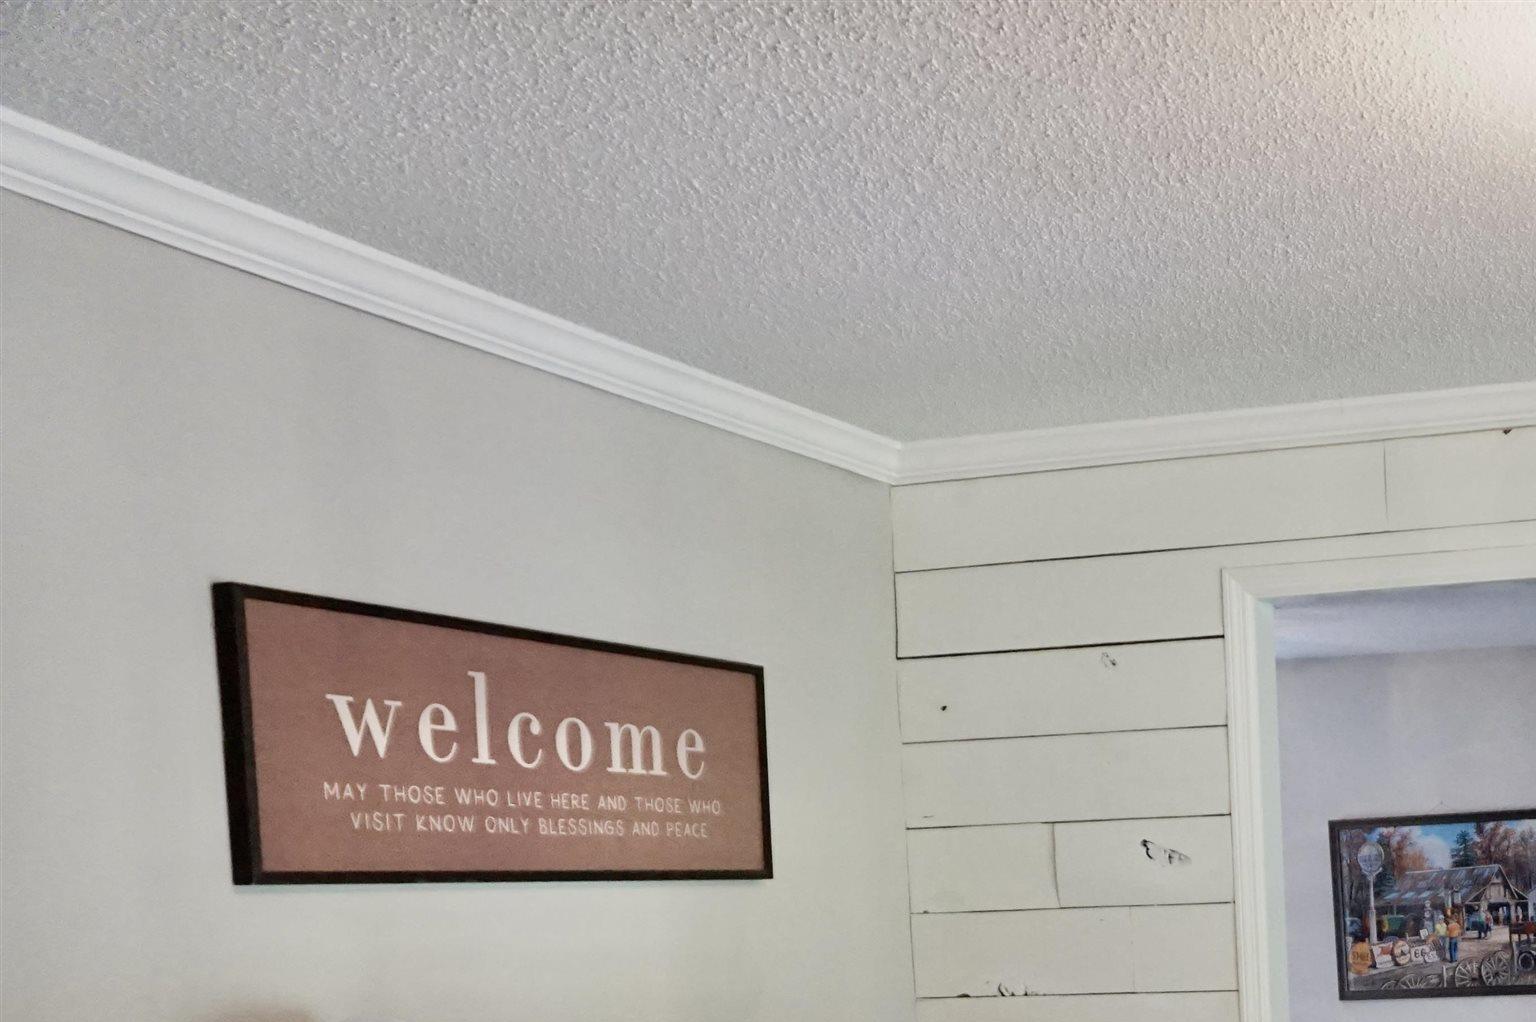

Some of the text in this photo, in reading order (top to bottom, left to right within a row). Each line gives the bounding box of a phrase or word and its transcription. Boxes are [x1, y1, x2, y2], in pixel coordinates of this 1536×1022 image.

[325, 671, 707, 780] welcome
[323, 781, 721, 815] MAY THOSE WHO LIVE HERE AND THOSE WHO
[350, 811, 708, 838] VISIT KNOW ONLY BLESSINGS AND PEACE
